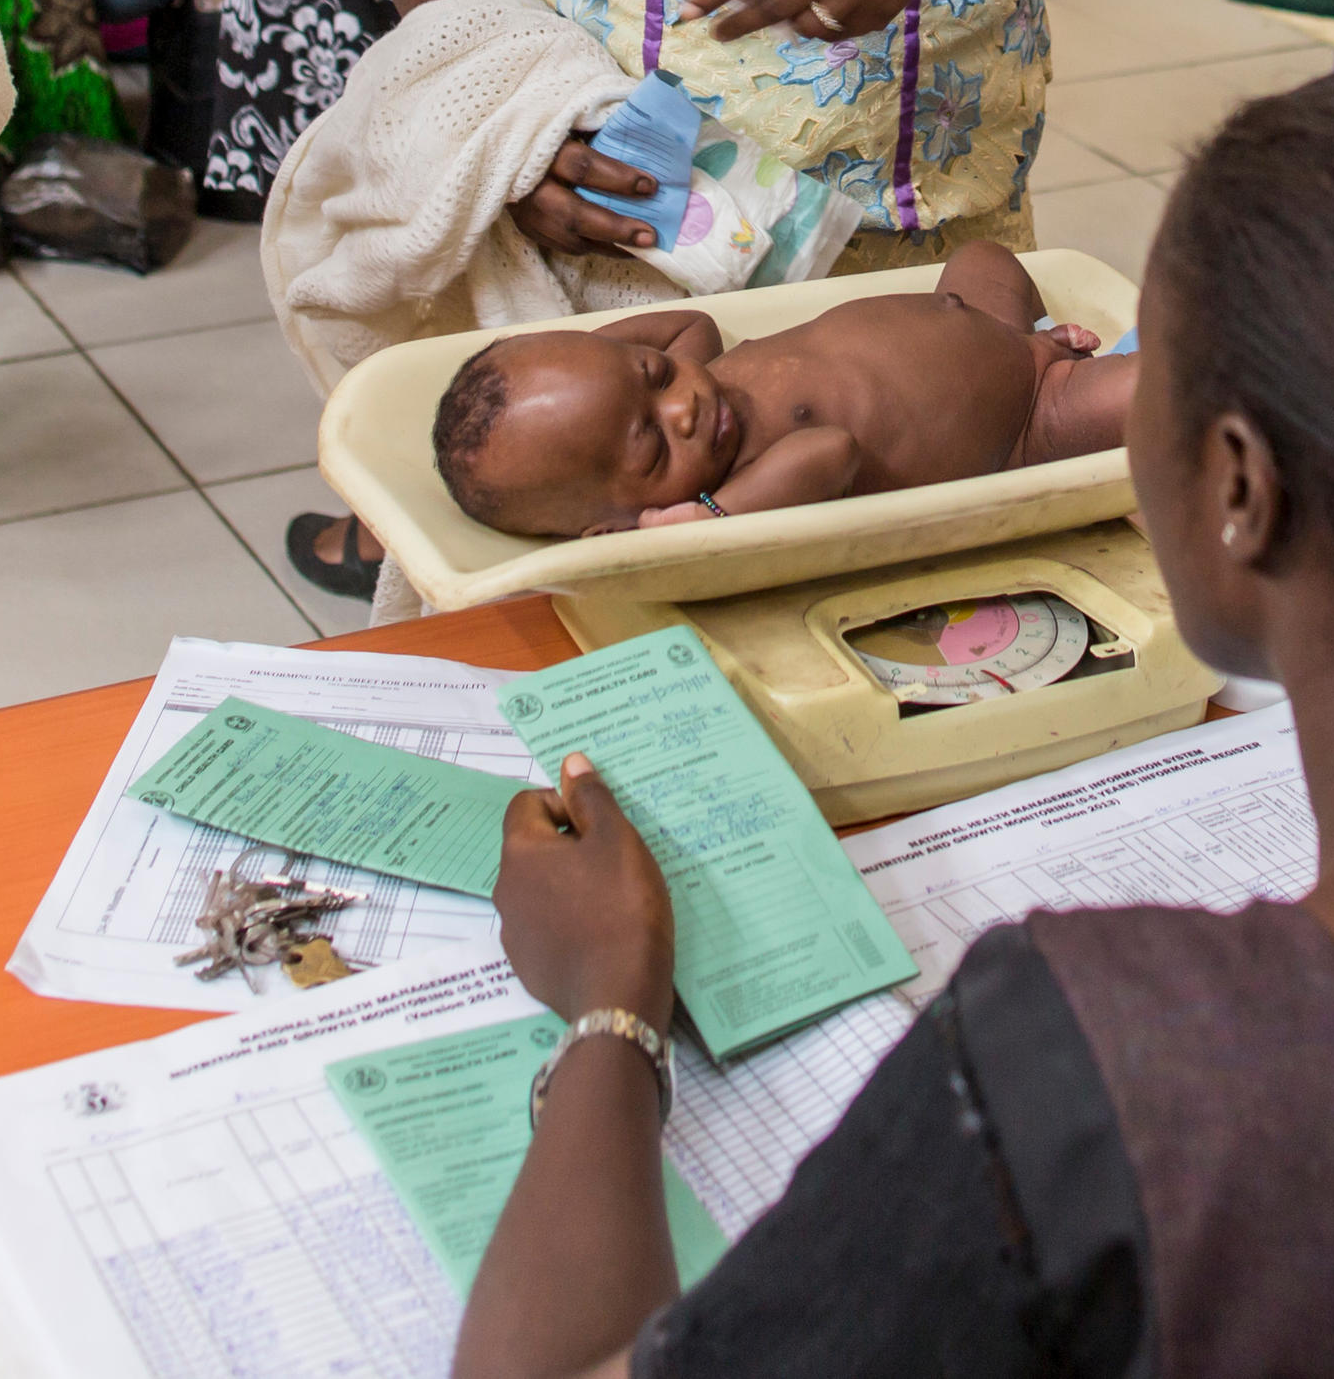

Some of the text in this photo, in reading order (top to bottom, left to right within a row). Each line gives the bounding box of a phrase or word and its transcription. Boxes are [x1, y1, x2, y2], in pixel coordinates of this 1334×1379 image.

[249, 669, 312, 681] DEWORMING
[443, 681, 489, 691] FACILITY
[551, 692, 583, 710] CHILD
[586, 678, 627, 698] HEALTH
[629, 668, 658, 683] CARD
[860, 741, 1262, 875] NUTRITION AND GROWTH MONITORING (0-5 YEARS) INFORMATION REGISTER
[908, 748, 1205, 848] NATIONAL HEALTH MANAGEMENT INFORMATION SYSTEM
[1040, 798, 1121, 828] (Version 2013)
[240, 1018, 313, 1044] NATIONAL
[317, 999, 373, 1022] HEALTH
[376, 969, 476, 1004] MANAGEMENT
[405, 986, 509, 1024] (Version 2013)
[169, 1048, 253, 1079] NUTRITION
[257, 1037, 288, 1052] AND
[292, 1019, 357, 1042] GROWTH
[361, 989, 455, 1022] MONITORING
[435, 1057, 482, 1077] HEALTH
[485, 1048, 518, 1063] CARD
